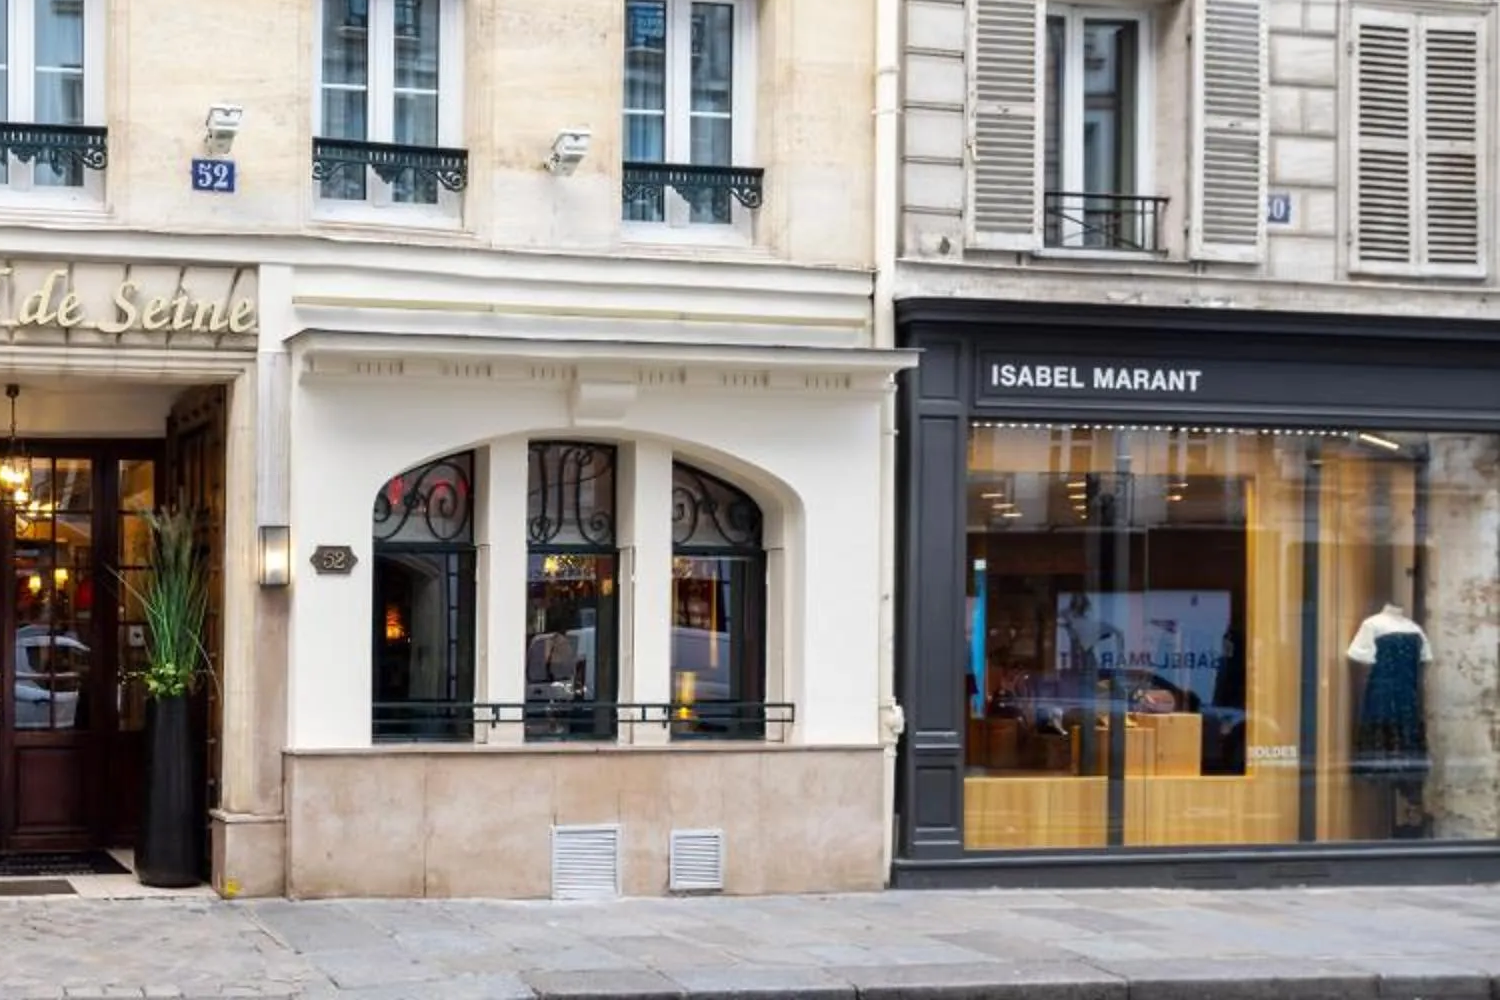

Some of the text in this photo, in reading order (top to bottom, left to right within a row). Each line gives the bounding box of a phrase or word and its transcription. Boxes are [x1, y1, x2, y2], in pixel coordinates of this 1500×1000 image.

[198, 162, 229, 189] 52
[17, 267, 86, 328] de
[98, 279, 257, 334] Seine
[991, 363, 1203, 392] ISABEL MARANT
[323, 551, 346, 569] 52
